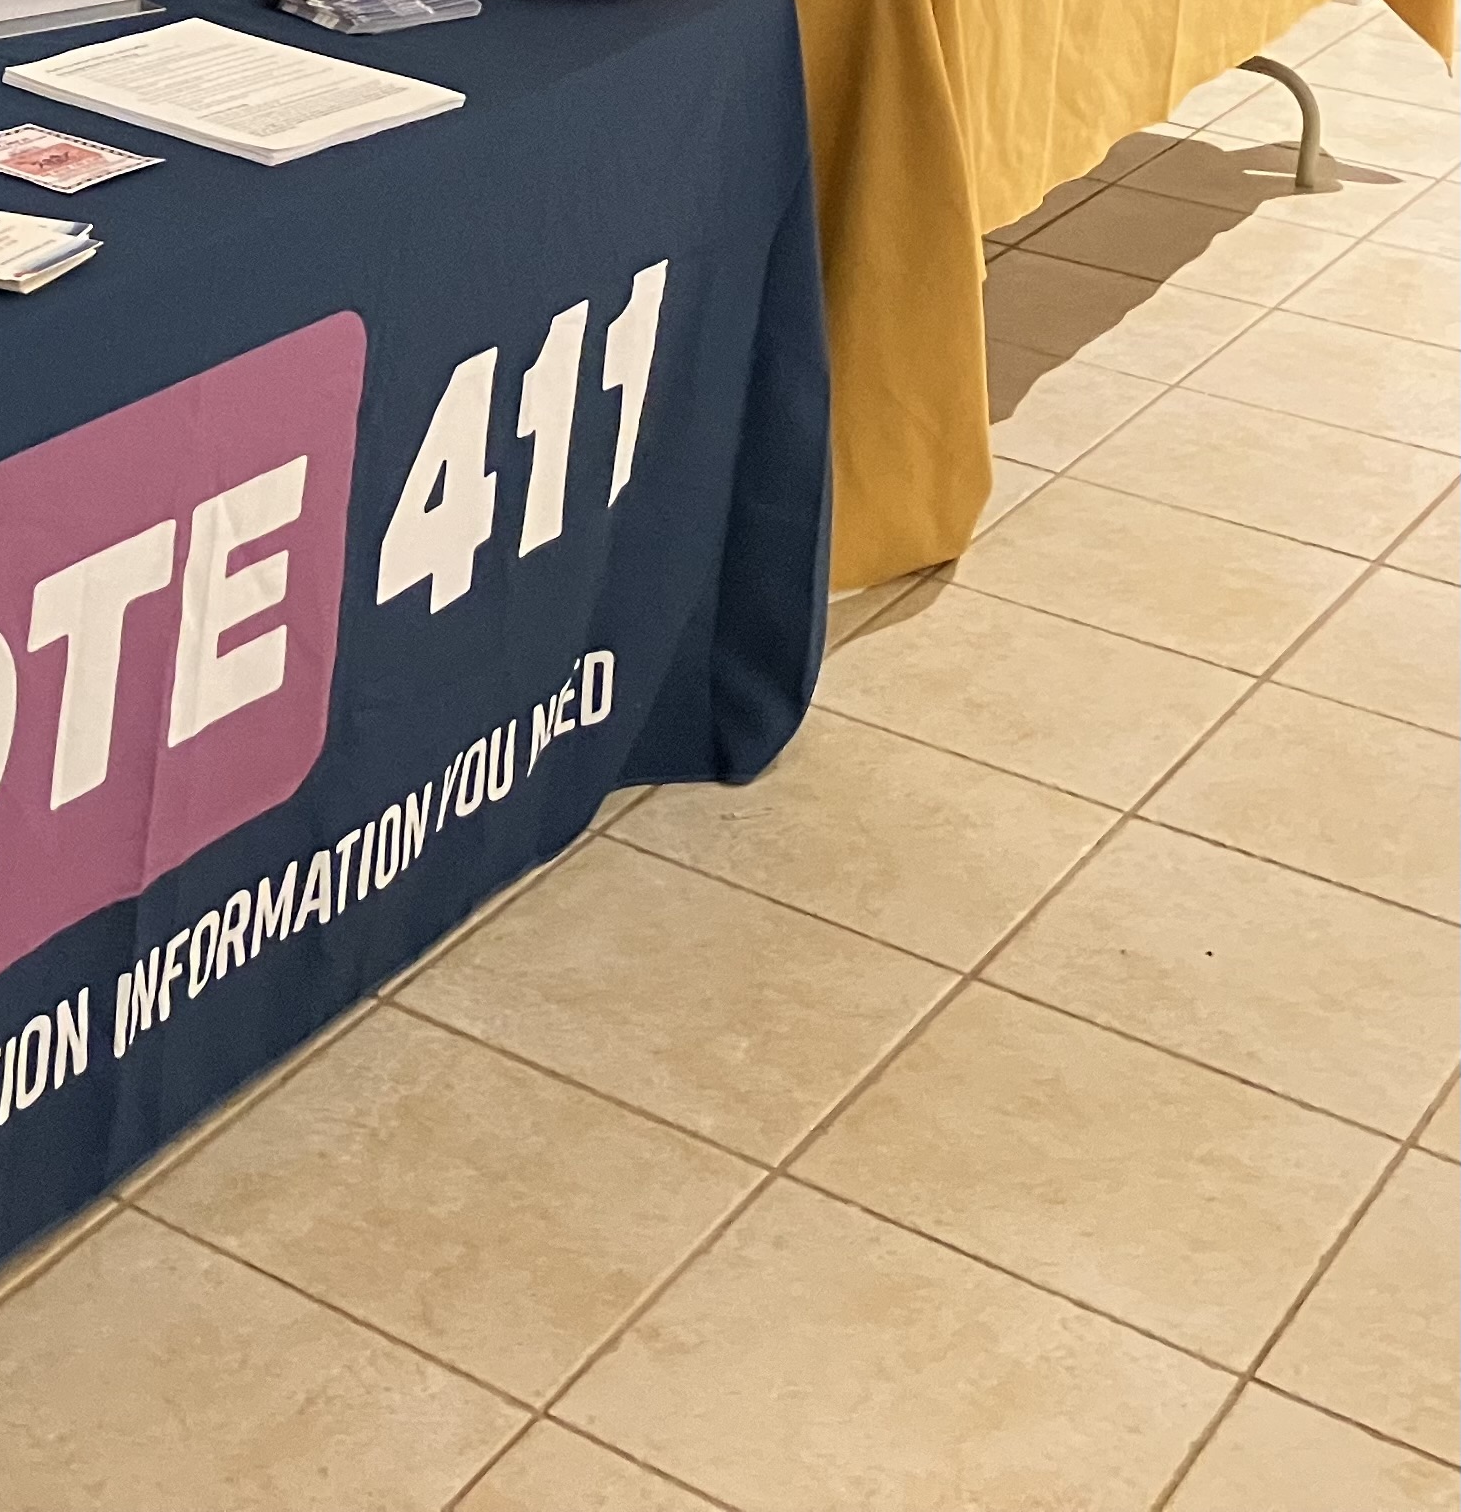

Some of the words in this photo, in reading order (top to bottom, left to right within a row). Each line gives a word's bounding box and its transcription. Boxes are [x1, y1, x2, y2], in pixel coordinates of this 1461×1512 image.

[377, 259, 669, 615] 411
[113, 781, 433, 1060] INFORMATION
[436, 719, 517, 833] YOU
